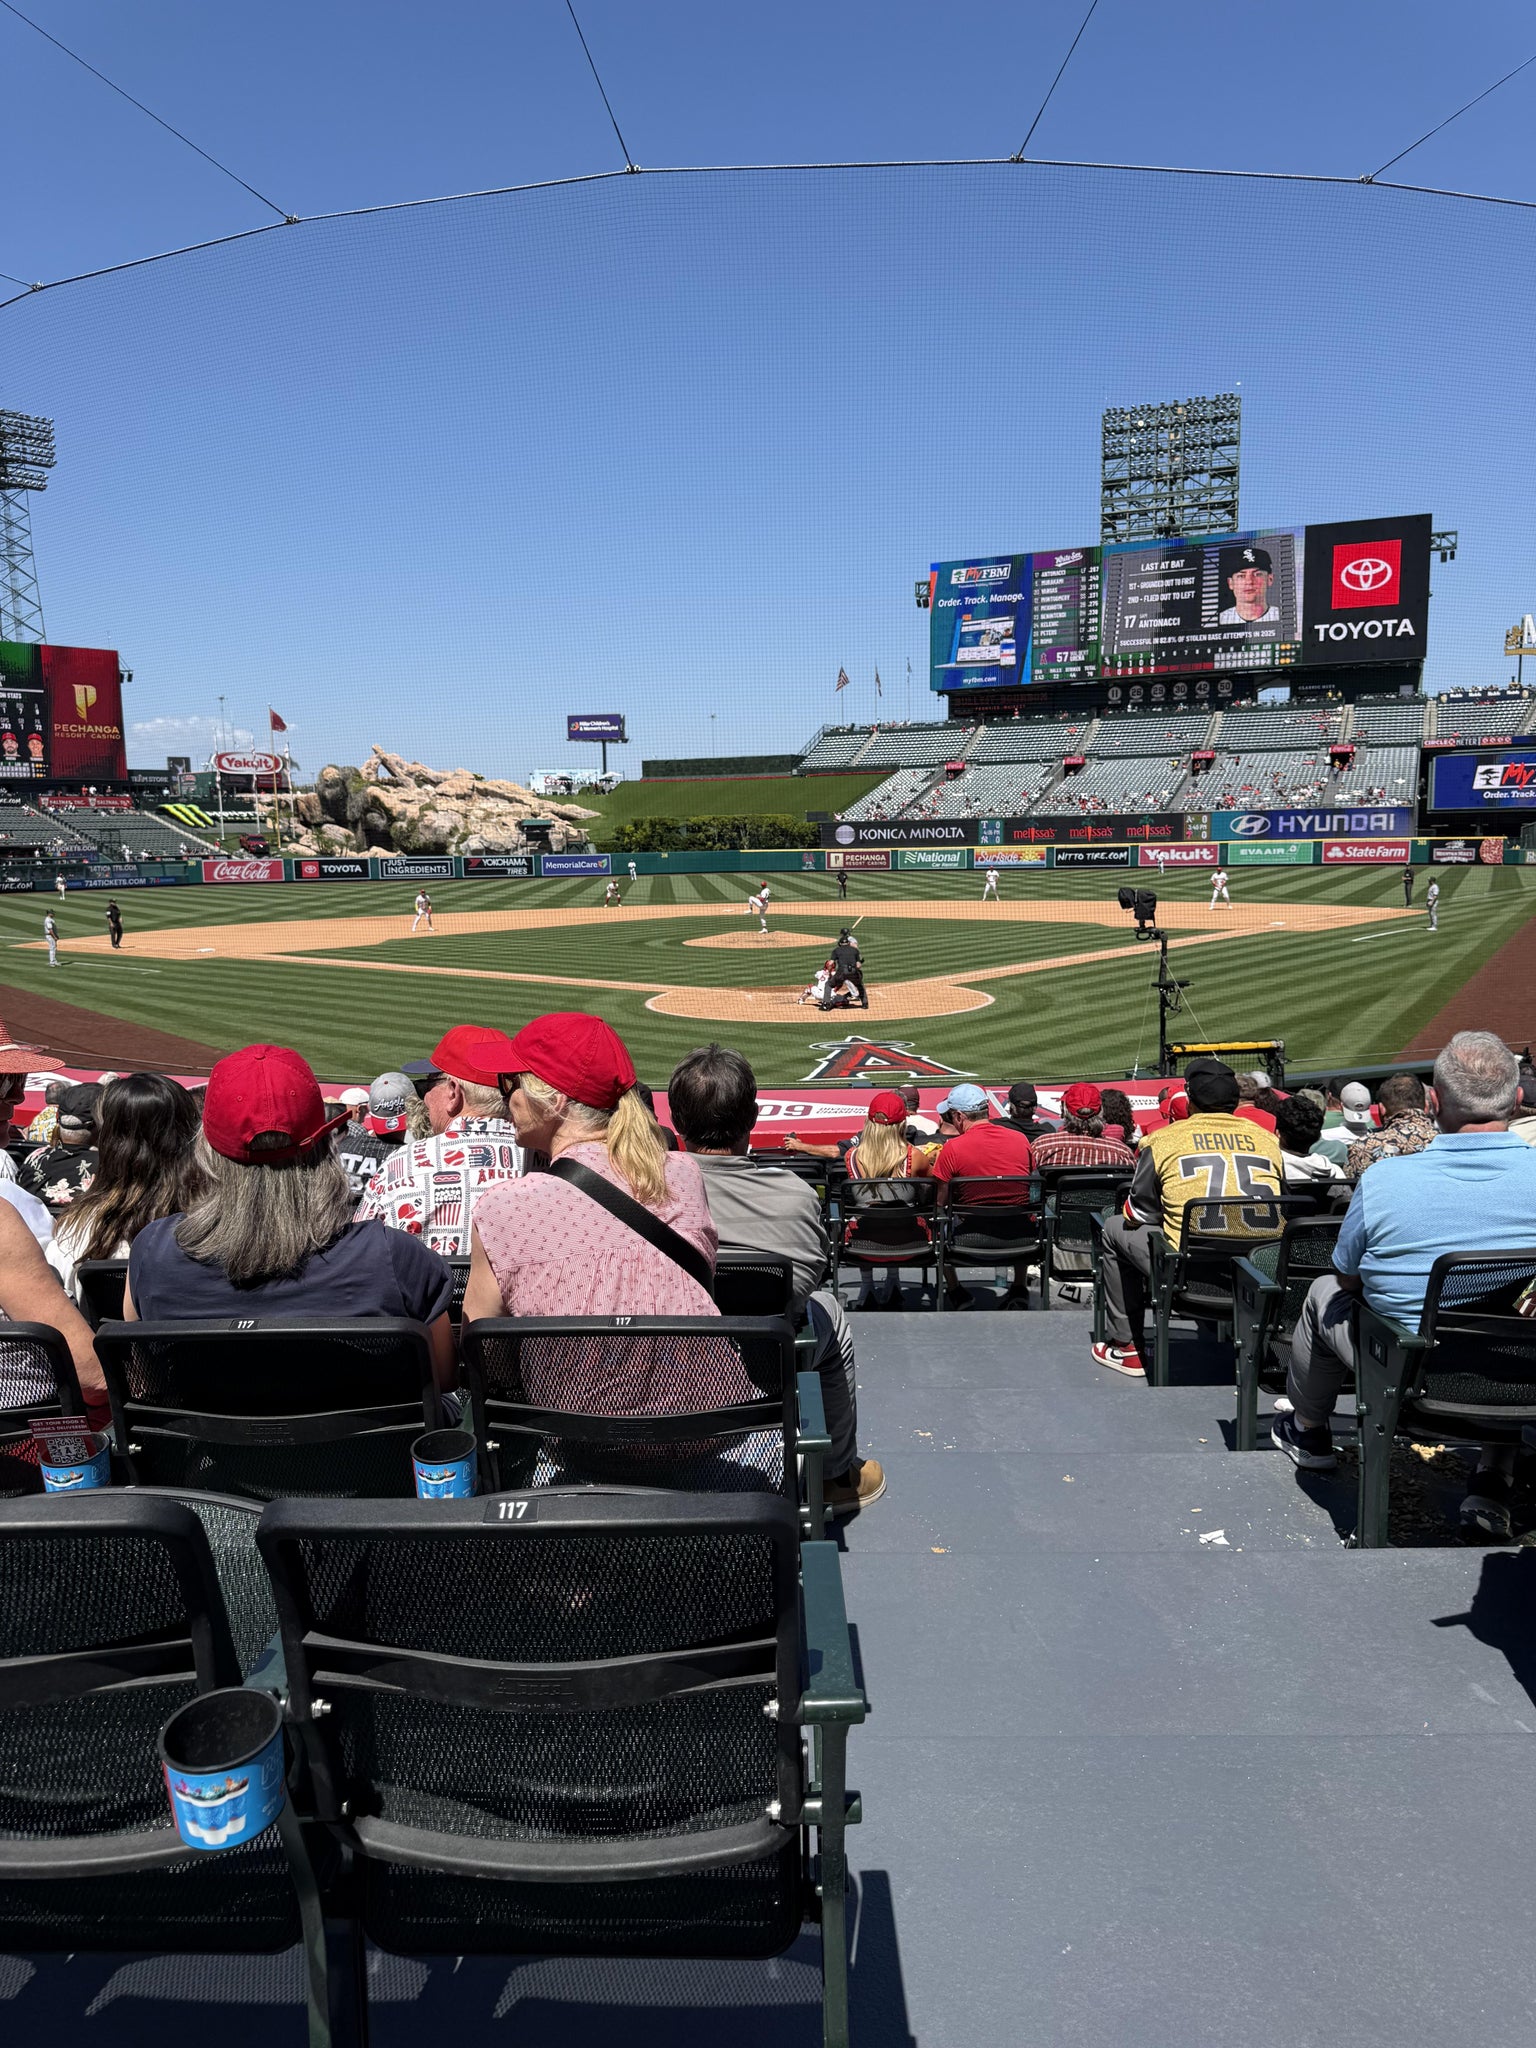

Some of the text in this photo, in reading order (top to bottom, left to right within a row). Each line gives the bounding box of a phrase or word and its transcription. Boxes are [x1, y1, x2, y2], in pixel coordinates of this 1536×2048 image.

[1141, 559, 1185, 571] LAST AT BAT
[1181, 577, 1195, 585] FIRST
[938, 593, 1025, 607] Order. Track. Manage.
[1180, 591, 1196, 599] LEFT
[1124, 615, 1180, 629] 17 ANTONACCI
[1314, 618, 1416, 642] TOYOTA
[1056, 651, 1069, 662] 57
[963, 676, 997, 684] myfbm.com
[1219, 681, 1230, 690] 50
[1196, 681, 1208, 691] 42
[54, 723, 119, 734] PECHANGA
[1279, 813, 1395, 833] HYUNDAI
[859, 827, 965, 840] KONICA MINOLTA
[917, 851, 960, 862] National
[978, 851, 1018, 864] Surfside
[1058, 851, 1127, 860] NITTO TIRE.COM
[482, 858, 528, 867] YOKOHAMA
[545, 860, 598, 870] MemorialCare
[213, 862, 272, 880] Coca-Cola
[322, 864, 363, 873] TOYOTA
[388, 865, 447, 874] INGREDIENTS
[507, 867, 528, 875] TIRES
[1193, 1133, 1256, 1152] REAVES
[1178, 1152, 1281, 1231] 75
[237, 1320, 255, 1329] 117
[616, 1317, 632, 1326] 117
[498, 1501, 529, 1520] 117
